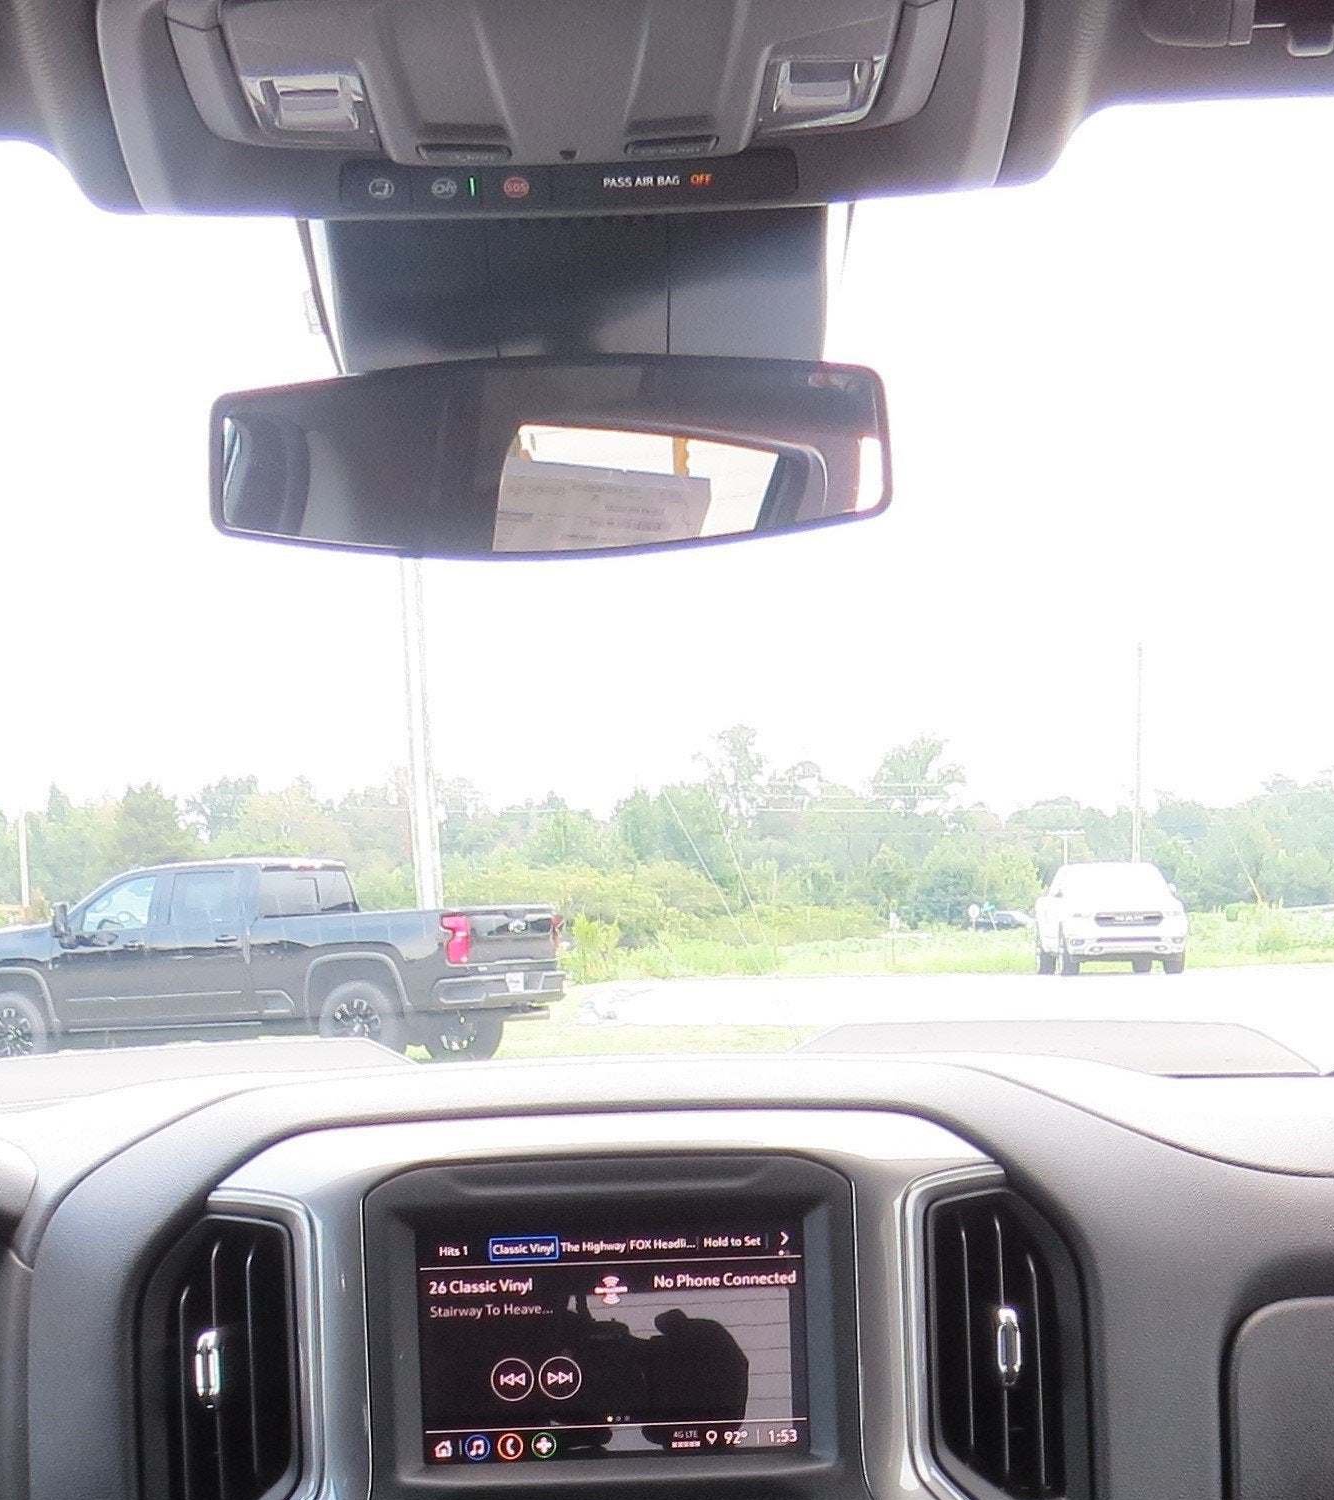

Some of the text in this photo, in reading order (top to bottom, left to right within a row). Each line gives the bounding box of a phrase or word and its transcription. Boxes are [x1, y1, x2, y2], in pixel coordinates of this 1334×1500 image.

[602, 173, 713, 188] PASS AIR BAG OFF
[492, 1242, 555, 1256] Classic Vinyl
[560, 1240, 627, 1255] The Highway
[629, 1239, 652, 1251] FOX
[703, 1235, 762, 1248] Hold to Set
[438, 1245, 469, 1257] Hits 1
[428, 1277, 533, 1296] 26 Classic Vinyl
[653, 1269, 797, 1289] No Phone Connected
[430, 1304, 484, 1320] Stairway
[485, 1303, 501, 1316] To
[767, 1428, 798, 1443] 1:53
